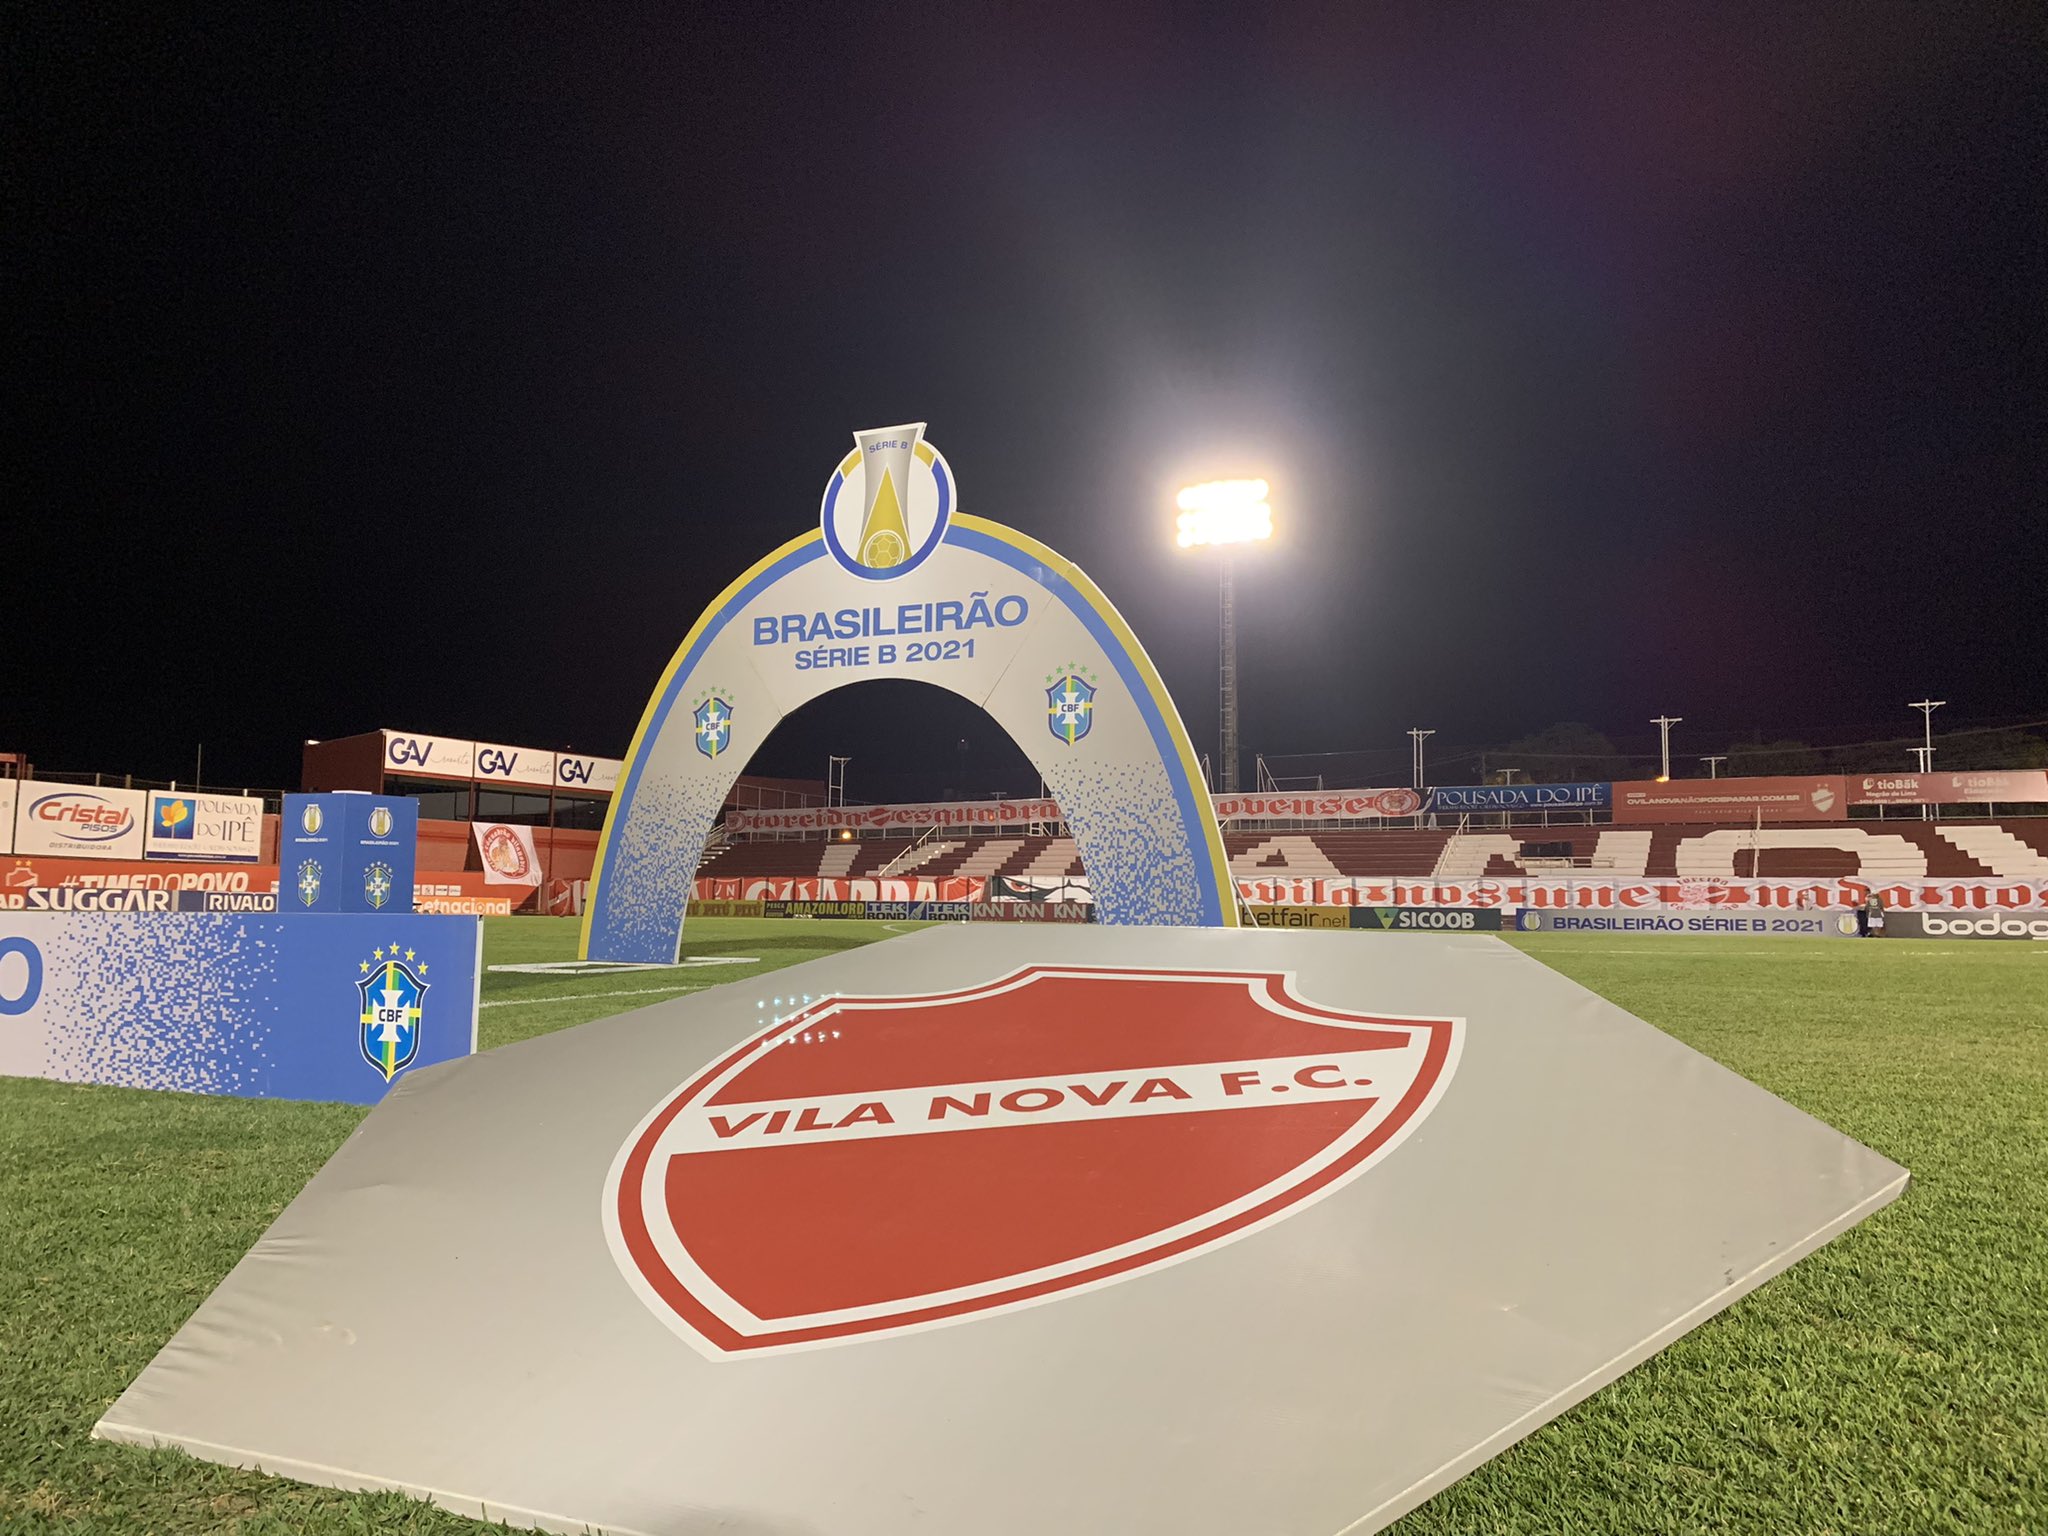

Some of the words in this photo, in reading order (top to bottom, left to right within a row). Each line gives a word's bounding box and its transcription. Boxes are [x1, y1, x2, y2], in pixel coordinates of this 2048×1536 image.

[869, 440, 898, 453] SÉRIE
[900, 441, 908, 450] B
[753, 590, 1029, 646] BRASILEIRÃO
[795, 644, 870, 670] SÉRIE
[878, 644, 897, 664] B
[905, 638, 975, 662] 2021
[1061, 704, 1079, 713] CBF
[706, 722, 720, 730] CBF
[388, 737, 433, 767] GAV
[478, 749, 518, 776] GAV
[559, 758, 595, 784] GAV
[1437, 789, 1529, 806] POUSADA
[1536, 787, 1571, 803] DO
[1576, 783, 1604, 802] IPÊ
[38, 801, 130, 825] Cristal
[197, 799, 258, 816] POUSADA
[1218, 795, 1372, 816] ovense
[80, 824, 118, 833] PISOS
[197, 823, 221, 837] DO
[222, 816, 255, 842] IPÊ
[49, 842, 112, 851] DISTRIBUIDORA
[27, 887, 169, 911] SUGGAR
[209, 894, 274, 911] RIVALO
[867, 903, 907, 912] TEK
[785, 902, 865, 915] AMAZONLORD
[867, 912, 907, 921] BOND
[928, 903, 969, 913] TEK
[973, 902, 1005, 918] KNN
[1013, 903, 1044, 918] KNN
[1054, 903, 1087, 919] KNN
[928, 912, 969, 922] BOND
[1399, 911, 1475, 929] SICOOB
[1553, 915, 1684, 931] BRASILEIRÃO
[1688, 915, 1748, 932] SÉRIE
[1752, 918, 1767, 932] B
[1771, 919, 1824, 933] 2021
[379, 1009, 403, 1022] CBF
[708, 1101, 896, 1139] VILA
[927, 1077, 1193, 1120] NOVA
[1219, 1064, 1373, 1097] F.C.
